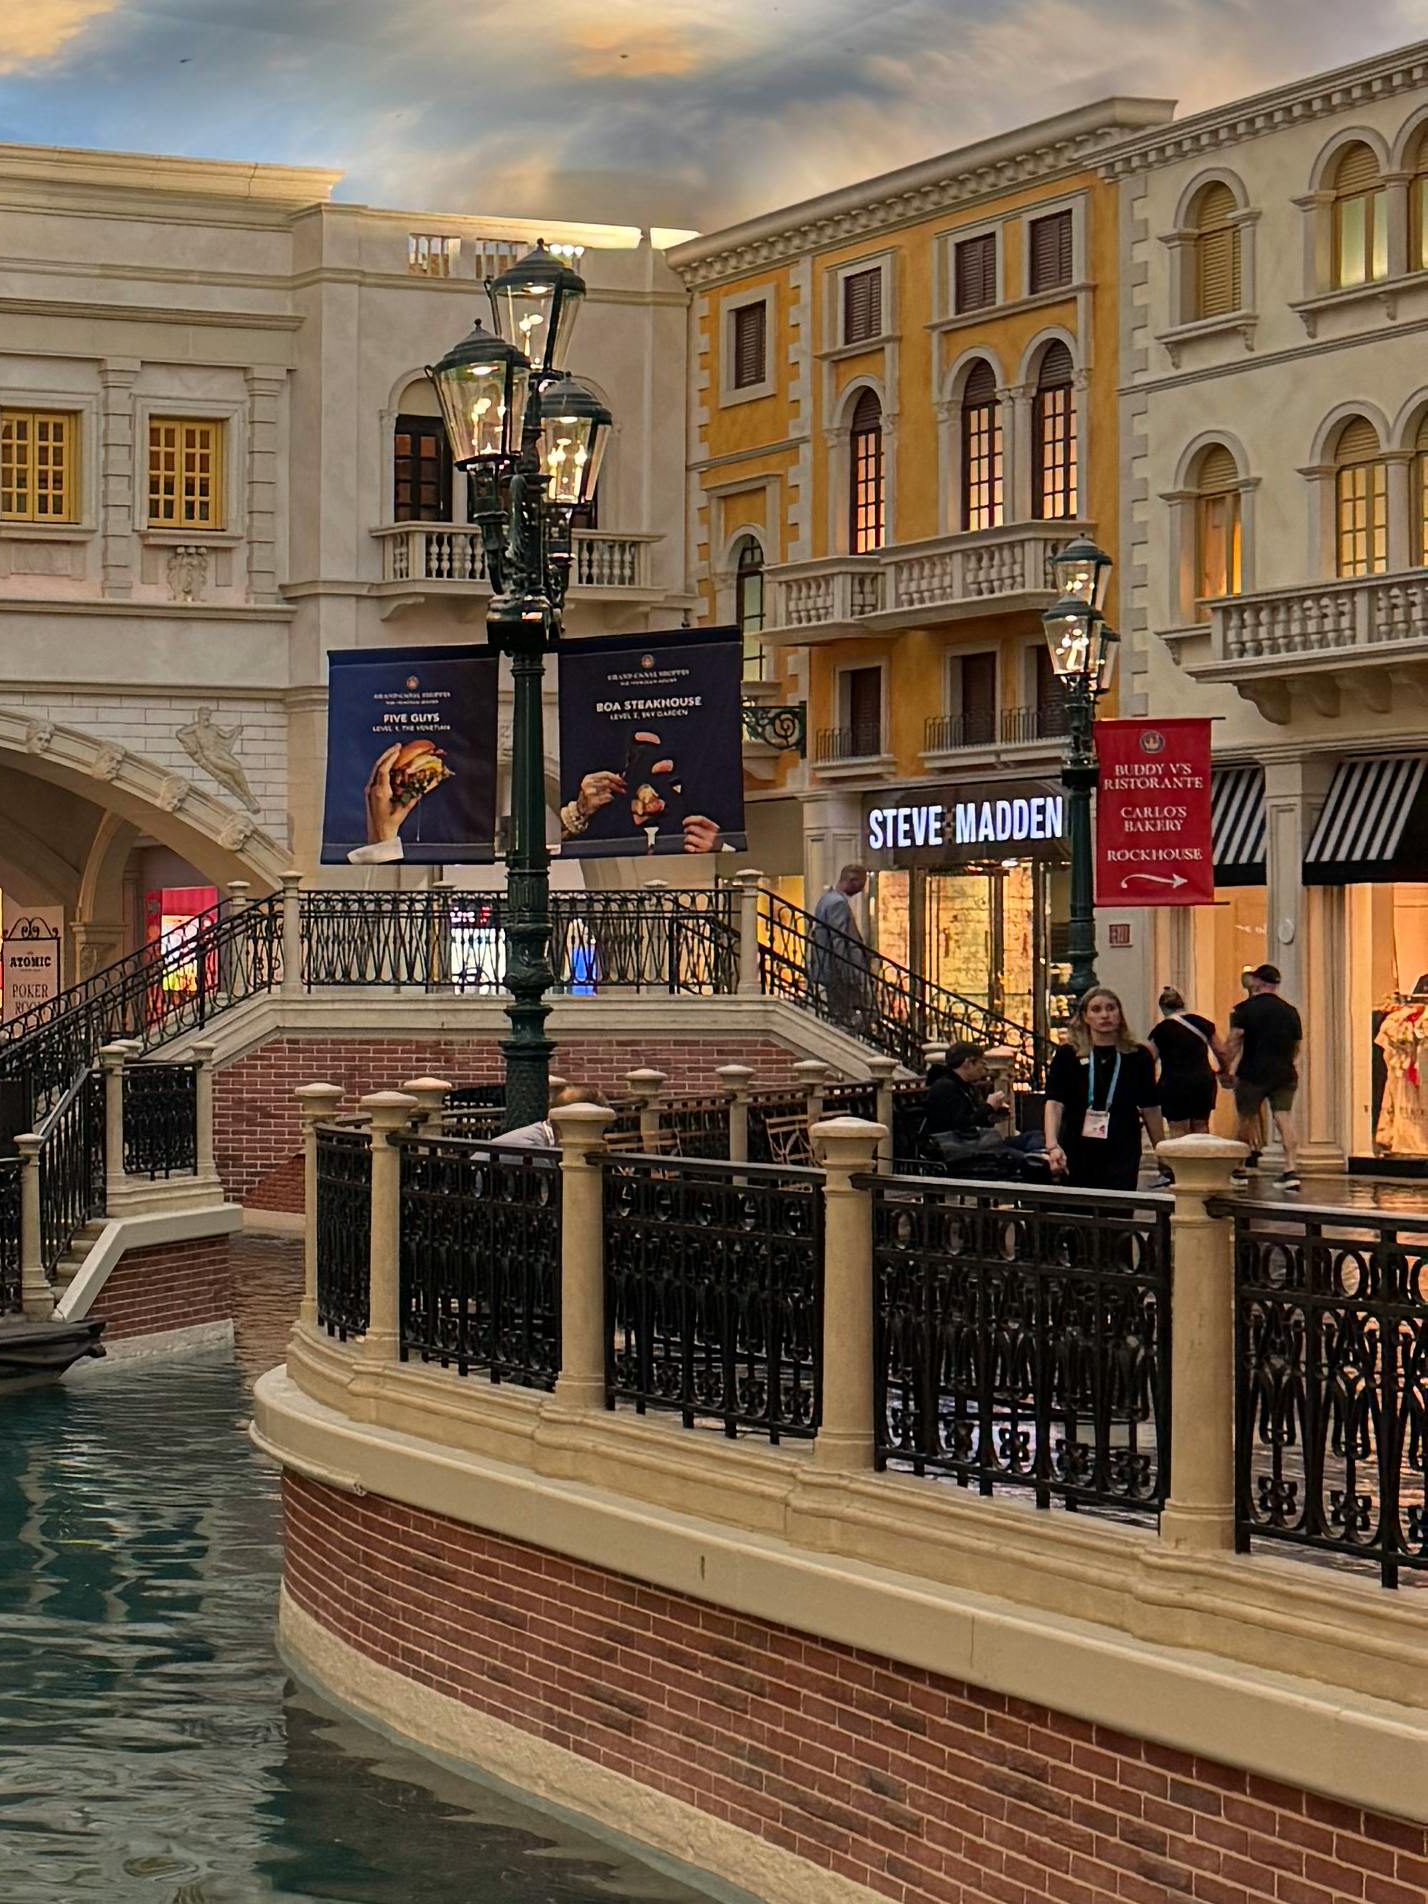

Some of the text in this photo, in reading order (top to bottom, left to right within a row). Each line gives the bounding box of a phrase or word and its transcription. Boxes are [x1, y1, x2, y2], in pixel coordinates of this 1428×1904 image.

[596, 696, 702, 712] BOA STEAKHOUSE
[383, 712, 440, 723] FIVE GUYS
[1114, 763, 1164, 776] BUDDY
[1104, 776, 1204, 790] RISTORANTE
[1120, 805, 1187, 819] CARLO'S
[868, 795, 1063, 850] STEVE MADDEN
[1124, 819, 1184, 832] BAKERY
[1107, 848, 1204, 862] ROCKHOUSE
[9, 956, 52, 969] ATOMIC
[12, 983, 49, 998] POKER
